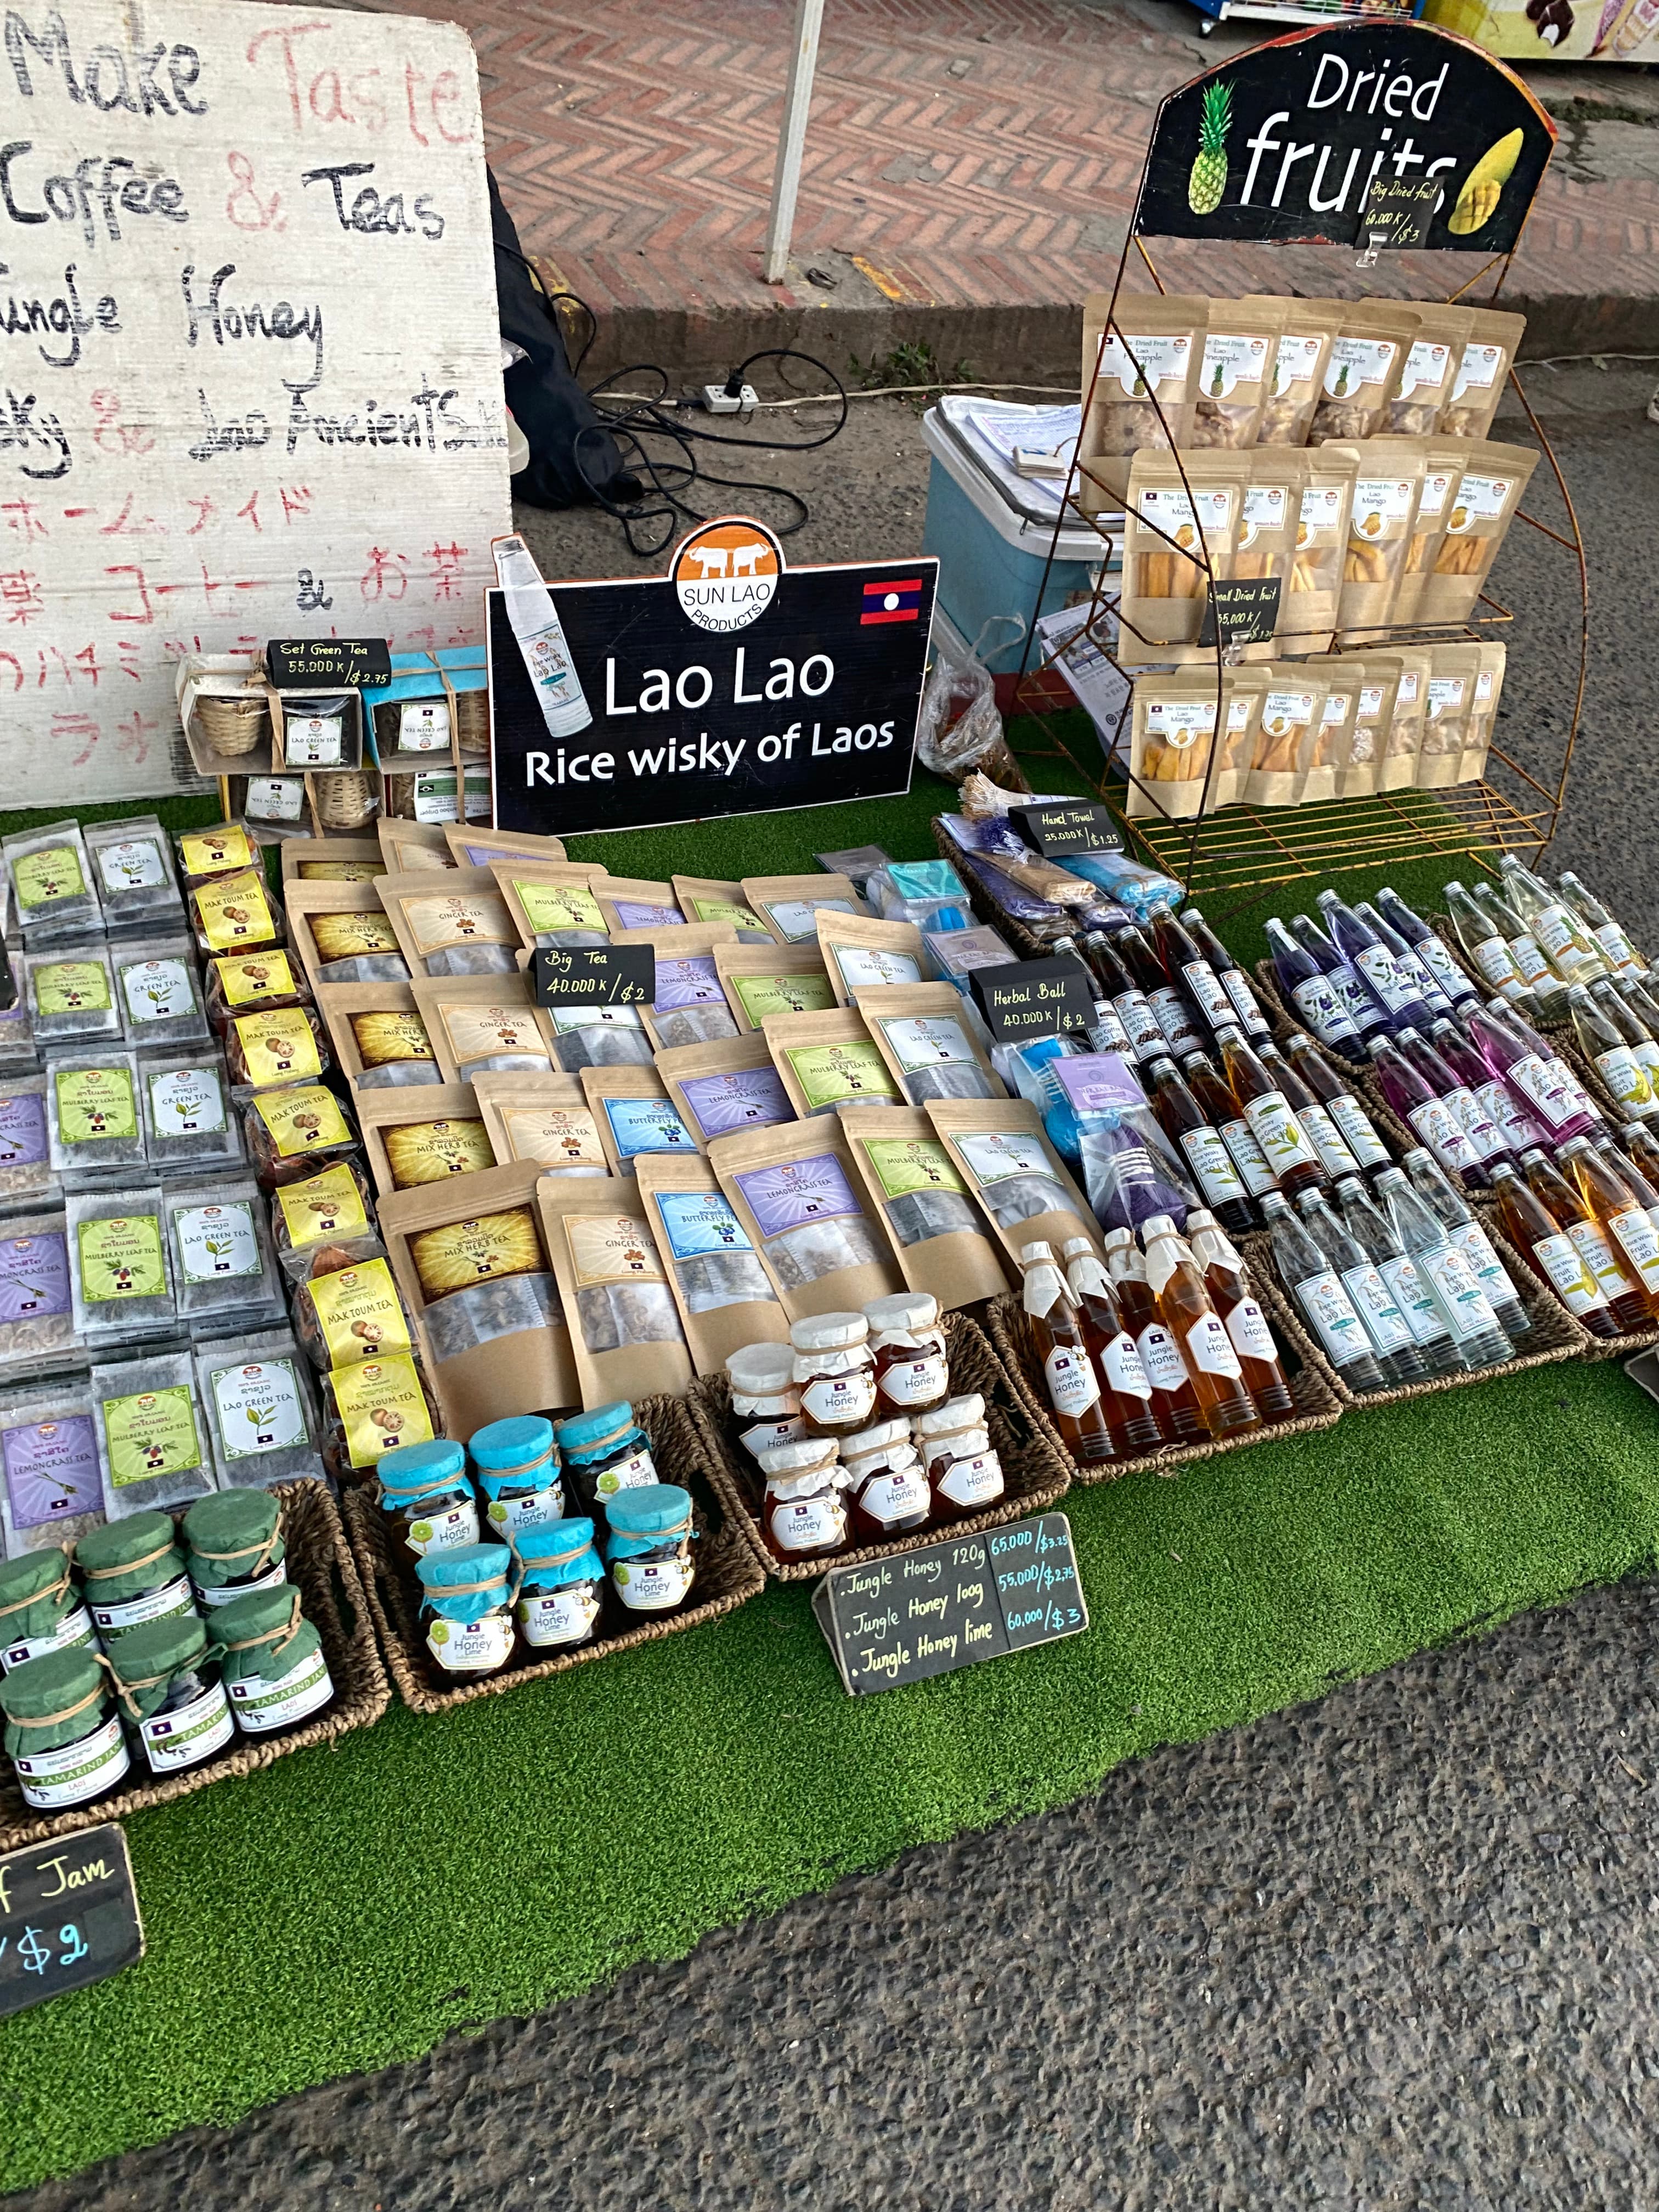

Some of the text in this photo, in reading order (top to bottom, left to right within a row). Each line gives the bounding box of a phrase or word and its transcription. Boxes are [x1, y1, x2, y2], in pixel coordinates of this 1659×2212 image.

[3, 10, 476, 146] Make Taste
[1307, 52, 1449, 121] Dried
[0, 141, 445, 249] Coffee & Teas
[1370, 181, 1388, 201] Big
[1389, 180, 1415, 197] Dried
[0, 263, 323, 393] ungle Honey
[1362, 498, 1386, 506] Mango
[296, 567, 332, 612] &
[684, 583, 771, 607] SUN LAO
[1233, 588, 1256, 601] Dried
[691, 603, 763, 633] PRODUCTS
[280, 642, 368, 655] Set Green Tea
[551, 661, 566, 672] Lao
[606, 647, 835, 716] Lao Lao
[527, 720, 895, 787] Rice wisky of Laos
[1042, 809, 1095, 825] Hand Towel
[545, 950, 608, 973] Big Tea
[134, 981, 161, 992] GREEN
[994, 981, 1066, 1007] Herbal Ball
[162, 1095, 193, 1106] GREEN
[417, 1139, 479, 1153] MIX HERB TEA
[681, 1214, 725, 1223] BUTTERFLY
[184, 1231, 251, 1245] LAO GREEN TEA
[605, 1239, 638, 1248] GINGER
[444, 1235, 511, 1258] MIX HERB TEA
[1630, 1243, 1648, 1255] Fruit
[85, 1250, 125, 1260] MULBERRY
[1586, 1252, 1604, 1263] Fruit
[1553, 1268, 1571, 1279] Fruit
[1556, 1274, 1575, 1286] Lao
[328, 1311, 349, 1325] MAK
[349, 1304, 376, 1317] TOUM
[376, 1299, 393, 1309] TEA
[1149, 1345, 1173, 1358] Jungle
[1147, 1353, 1181, 1370] Honey
[905, 1374, 936, 1389] Honey
[910, 1370, 930, 1380] Jungle
[1054, 1370, 1080, 1383] Jungle
[831, 1389, 852, 1399] Jungle
[1054, 1379, 1086, 1395] Honey
[223, 1402, 242, 1412] LAO
[245, 1397, 274, 1408] GREEN
[347, 1402, 369, 1413] MAK
[370, 1396, 397, 1406] TOUM
[399, 1391, 417, 1401] TEA
[825, 1394, 859, 1408] Honey
[112, 1429, 155, 1443] MULBERRY
[156, 1425, 174, 1434] LEAF
[13, 1453, 92, 1475] LEMONGRASS TEA
[512, 1508, 548, 1526] Honey
[793, 1514, 814, 1525] Jungle
[787, 1519, 821, 1533] Honey
[847, 1544, 986, 1599] Jungle Honey 120g
[634, 1581, 670, 1594] Honey
[640, 1576, 663, 1585] Jungle
[853, 1607, 900, 1640] Jungle
[908, 1594, 949, 1620] Honey
[454, 1638, 492, 1652] Honey
[461, 1632, 485, 1643] Jungle
[465, 1648, 482, 1656] Lime
[860, 1618, 993, 1678] Jungle Honey lime
[253, 1678, 311, 1709] TAMARIND
[37, 1756, 104, 1787] TAMARIND
[37, 1855, 115, 1897] Jam
